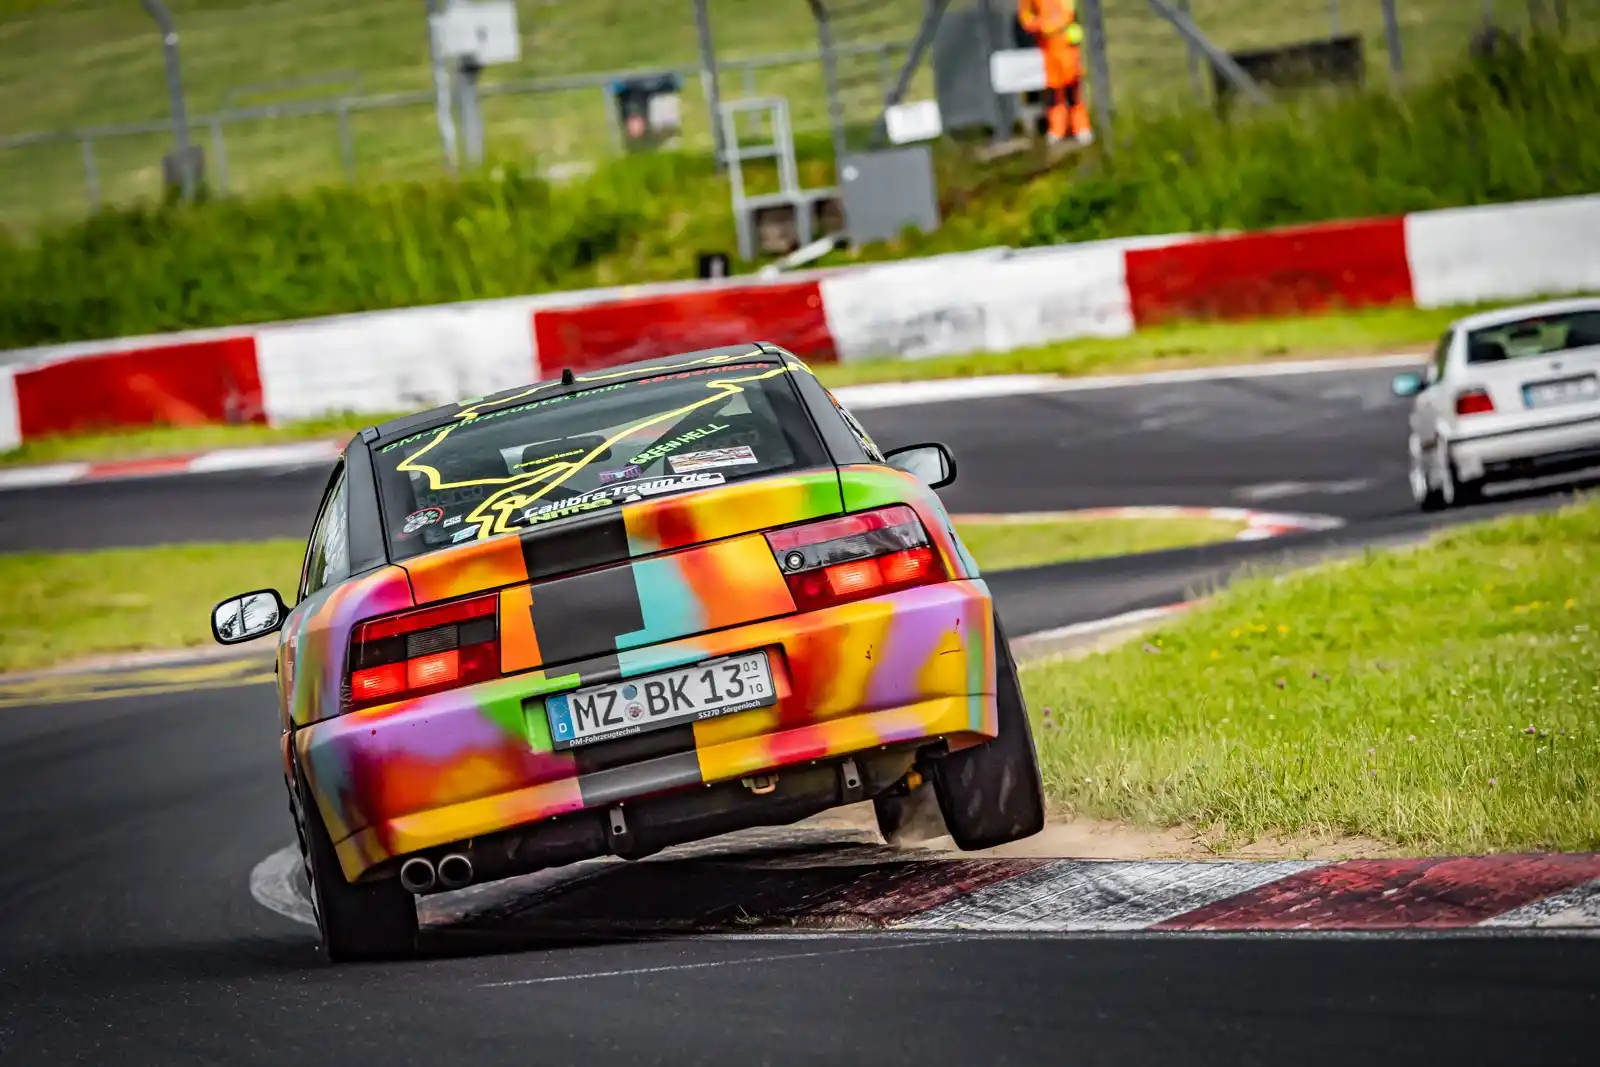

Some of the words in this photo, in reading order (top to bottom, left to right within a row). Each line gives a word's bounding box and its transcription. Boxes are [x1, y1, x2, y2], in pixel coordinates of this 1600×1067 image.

[629, 438, 682, 465] GREEN
[678, 422, 730, 448] HELL
[524, 472, 711, 520] Calibra-Team.de
[529, 498, 613, 525] NITRO
[743, 660, 758, 672] 03
[573, 690, 624, 731] MZ
[644, 674, 695, 716] BK
[700, 664, 744, 704] 13
[749, 683, 764, 695] 10
[558, 722, 568, 733] D
[569, 726, 641, 747] DM-Fahrzeugtechnik
[698, 708, 720, 720] 55270
